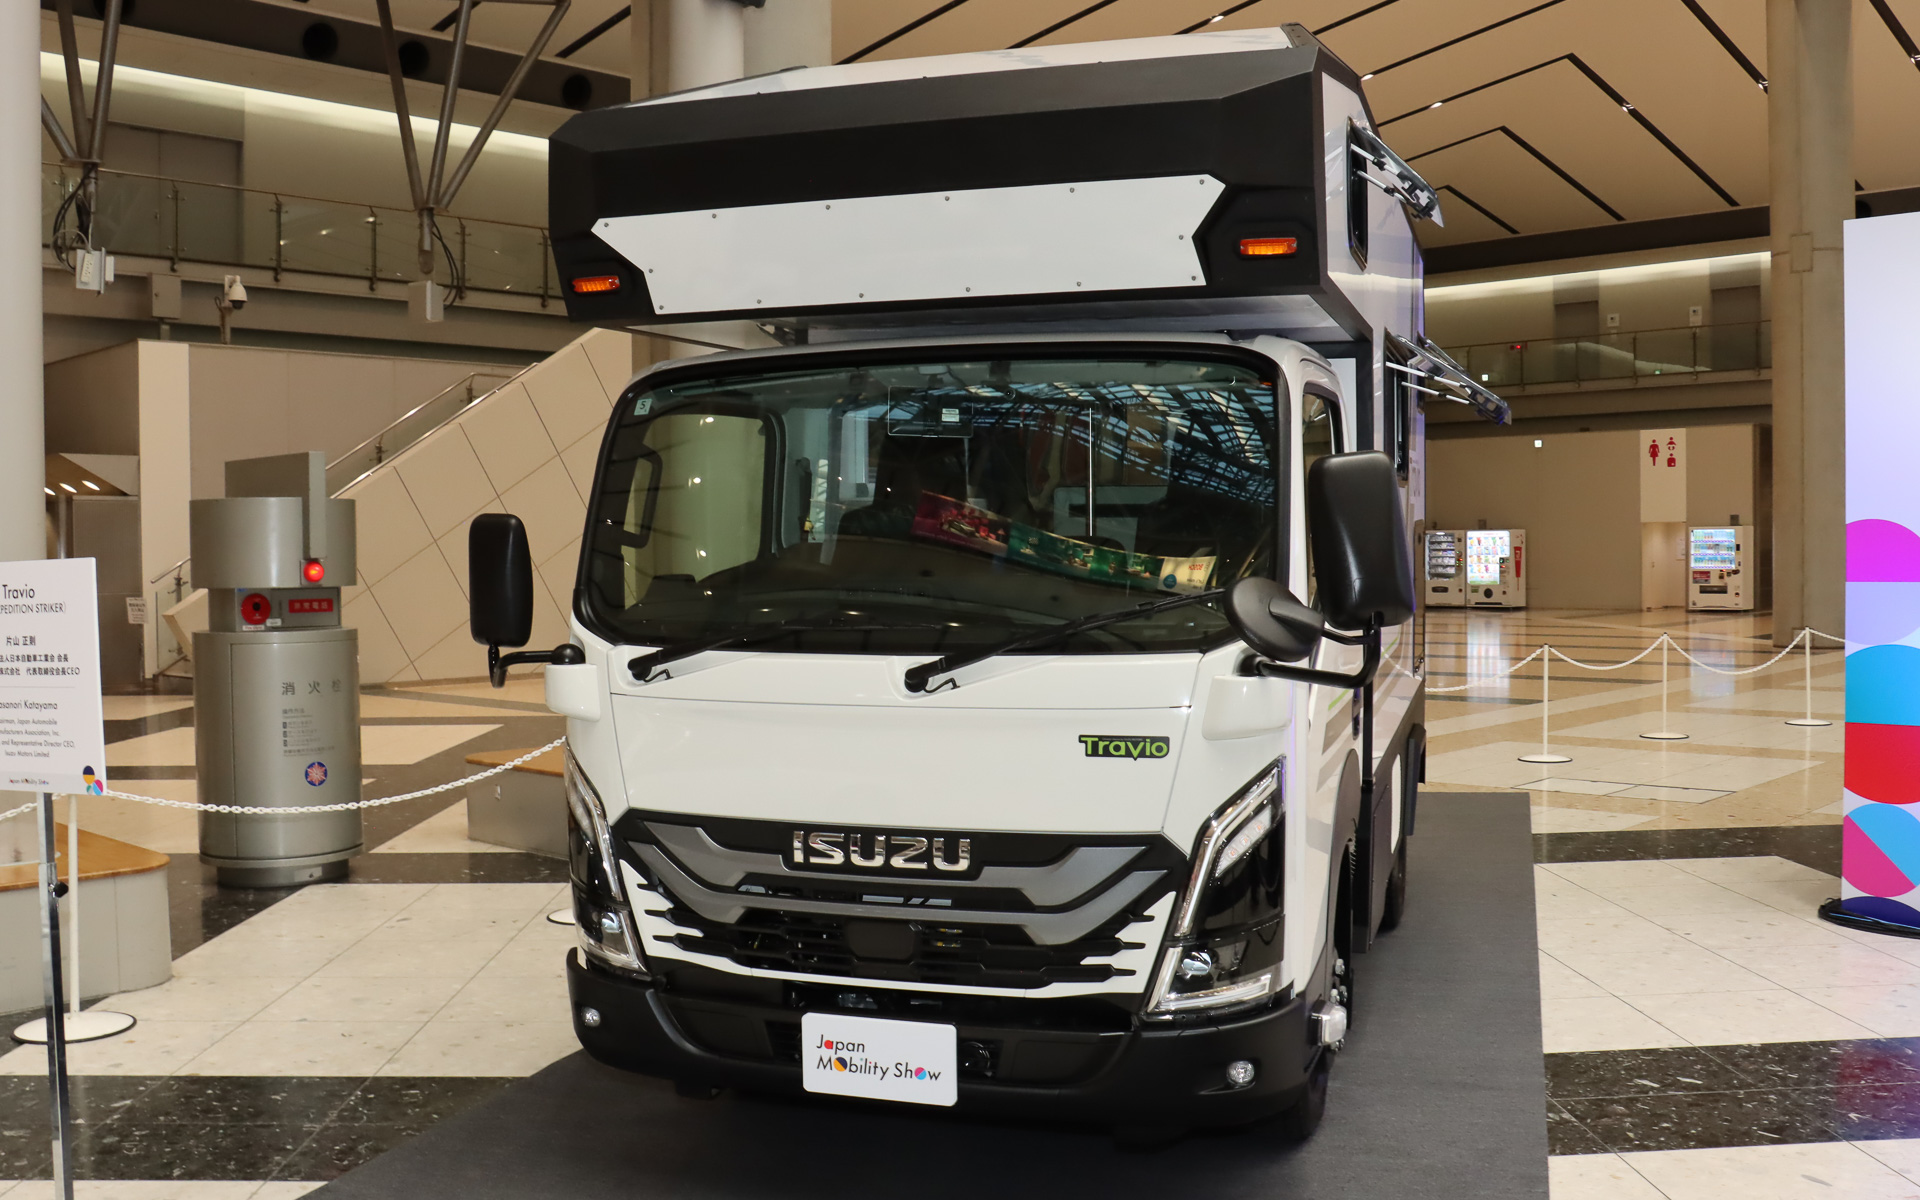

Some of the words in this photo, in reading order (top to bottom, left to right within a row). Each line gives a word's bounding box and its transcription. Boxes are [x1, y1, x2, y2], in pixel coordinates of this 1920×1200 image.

[640, 401, 647, 410] 5
[2, 584, 36, 599] Travio
[0, 604, 33, 614] PEDITION
[35, 601, 66, 613] STRIKER)
[6, 635, 20, 647] 片山
[24, 699, 58, 712] Katayama
[1080, 737, 1168, 758] Travio
[793, 831, 971, 871] ISUZU
[816, 1034, 865, 1055] Japan
[816, 1054, 889, 1081] Mobility
[893, 1062, 941, 1081] Show
